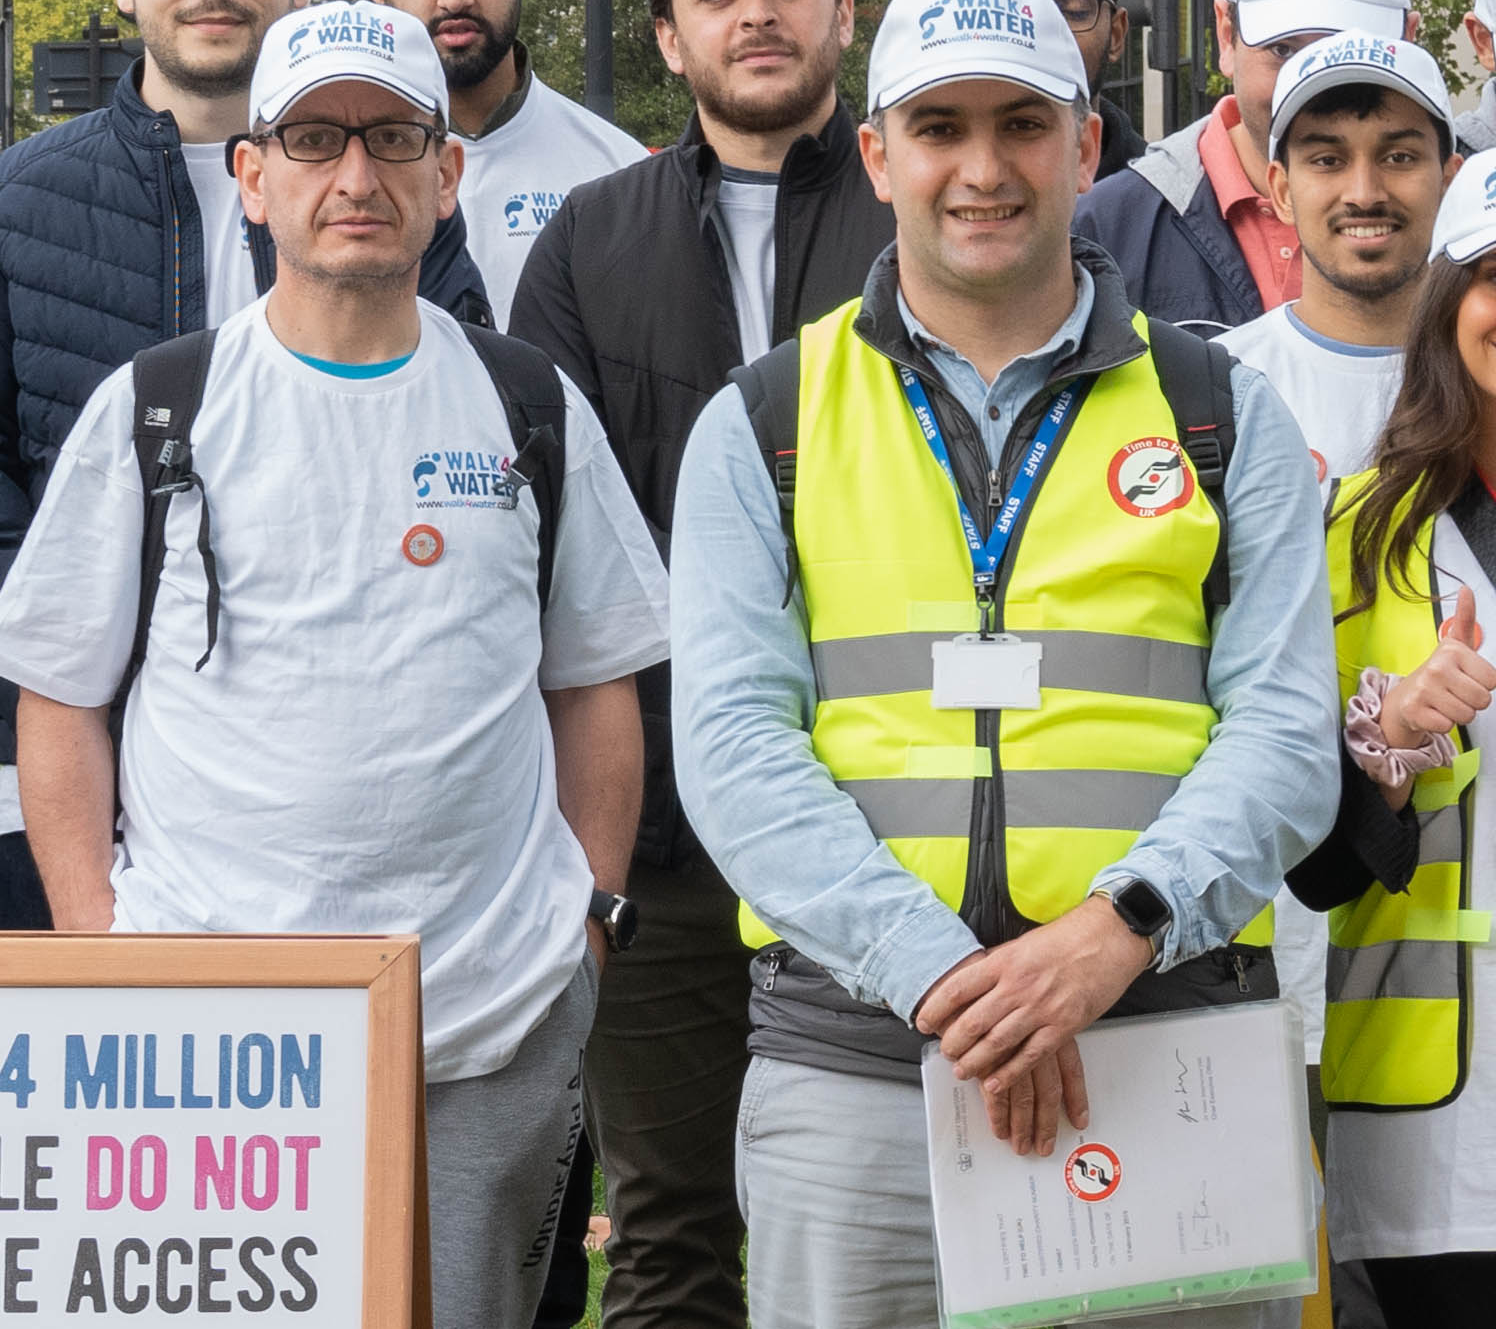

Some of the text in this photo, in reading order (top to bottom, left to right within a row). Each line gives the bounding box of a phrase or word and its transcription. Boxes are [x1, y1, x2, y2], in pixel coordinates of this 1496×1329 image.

[317, 25, 395, 53] WATER
[321, 11, 394, 35] WALK4
[953, 9, 1036, 40] WATER
[1324, 47, 1395, 69] WATER
[1327, 37, 1396, 55] WALK4
[915, 405, 937, 440] STAFF
[1052, 390, 1072, 425] STAFF
[444, 451, 510, 471] WALK4
[1024, 441, 1047, 478] STAFF
[1123, 438, 1154, 458] Time
[1156, 438, 1169, 450] to
[997, 496, 1021, 535] STAFF
[1139, 509, 1156, 518] UK
[962, 511, 981, 552] STAFF
[63, 1032, 322, 1111] MILLION
[85, 1134, 169, 1213] DO
[193, 1134, 321, 1213] NOT
[65, 1235, 320, 1315] ACCESS
